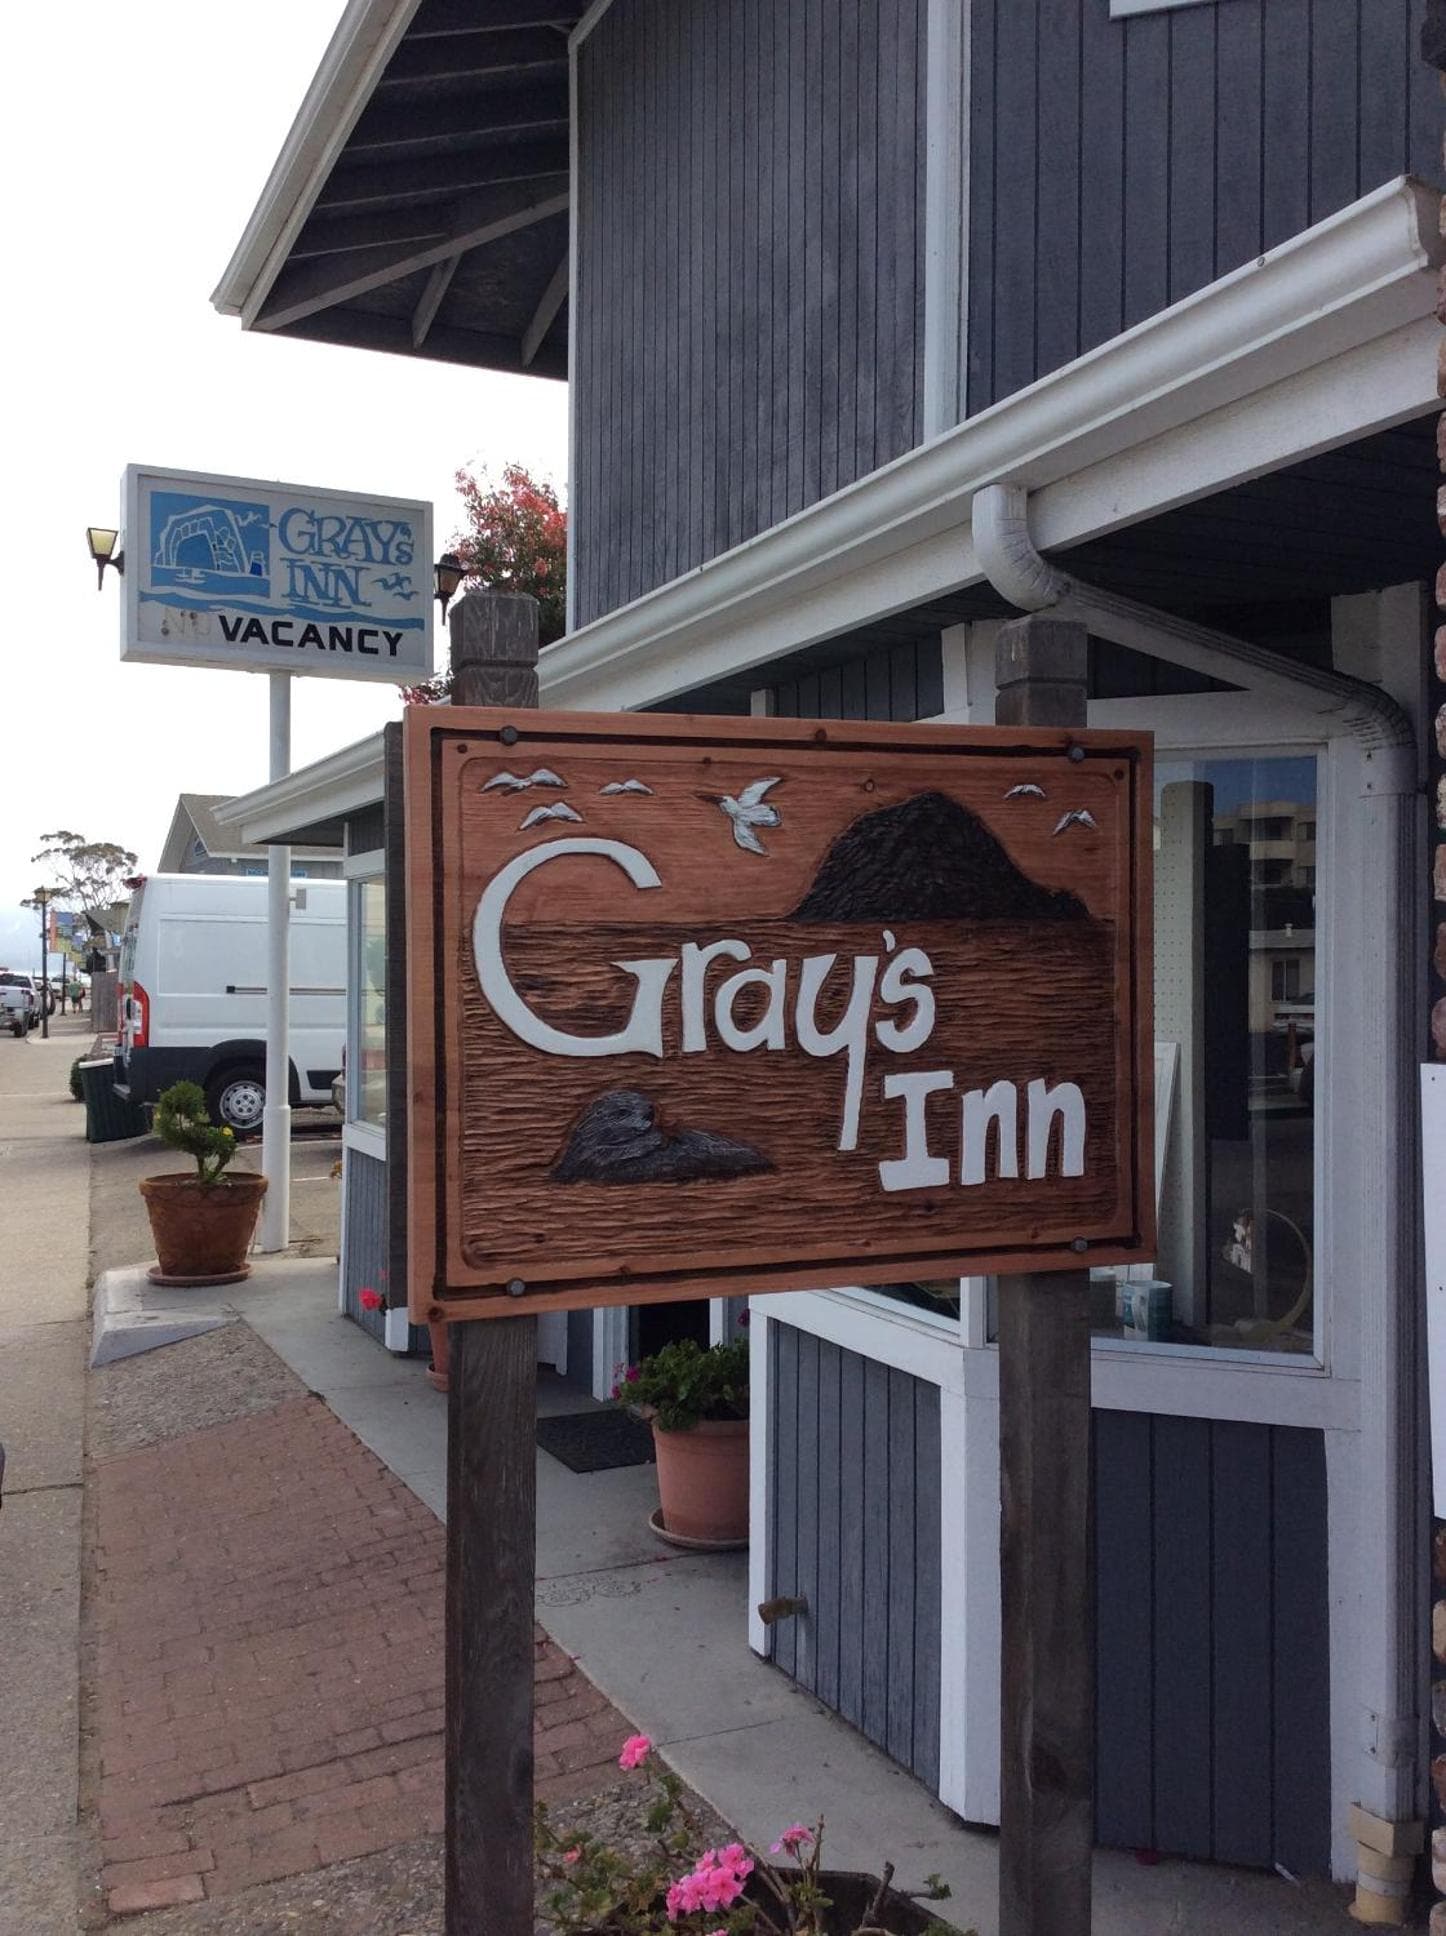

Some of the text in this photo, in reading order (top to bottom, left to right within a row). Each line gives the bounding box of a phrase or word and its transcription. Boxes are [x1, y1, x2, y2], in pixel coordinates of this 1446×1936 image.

[279, 557, 373, 609] INN
[218, 614, 404, 657] VACANCY
[472, 837, 937, 1152] Gray's
[879, 1069, 1087, 1191] Inn
